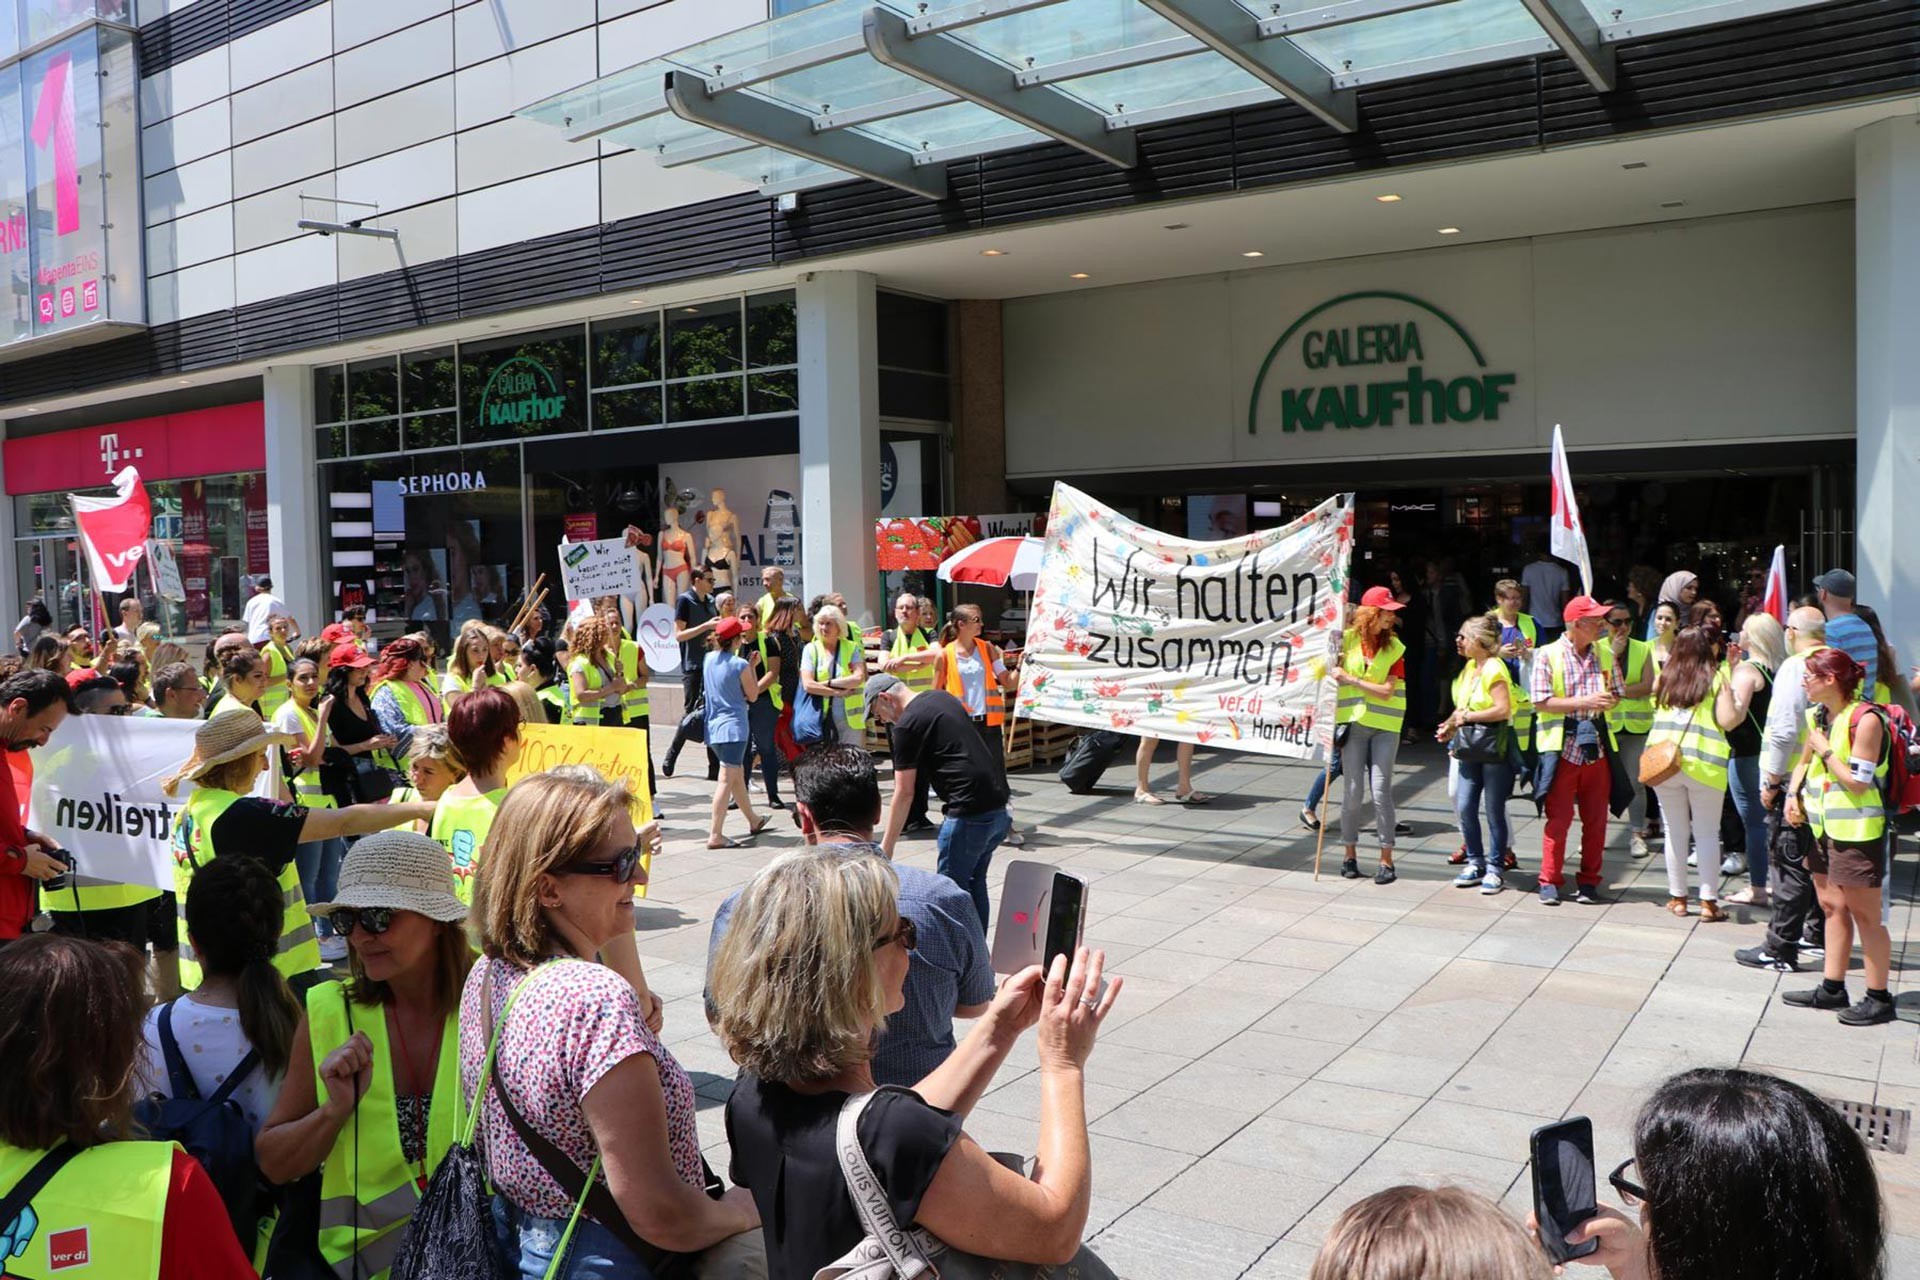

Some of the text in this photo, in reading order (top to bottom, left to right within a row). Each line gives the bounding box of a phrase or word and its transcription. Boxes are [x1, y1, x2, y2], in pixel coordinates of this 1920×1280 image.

[1302, 320, 1425, 370] GALERIA
[498, 373, 537, 396] GALERIA
[398, 470, 487, 495] SEPHORA
[1092, 536, 1318, 626] Wir halten
[1086, 631, 1292, 687] zusammen
[1217, 690, 1264, 716] ver.di
[1252, 715, 1314, 748] Handel
[844, 1144, 872, 1191] LOUIS
[866, 1191, 913, 1260] VUITTON
